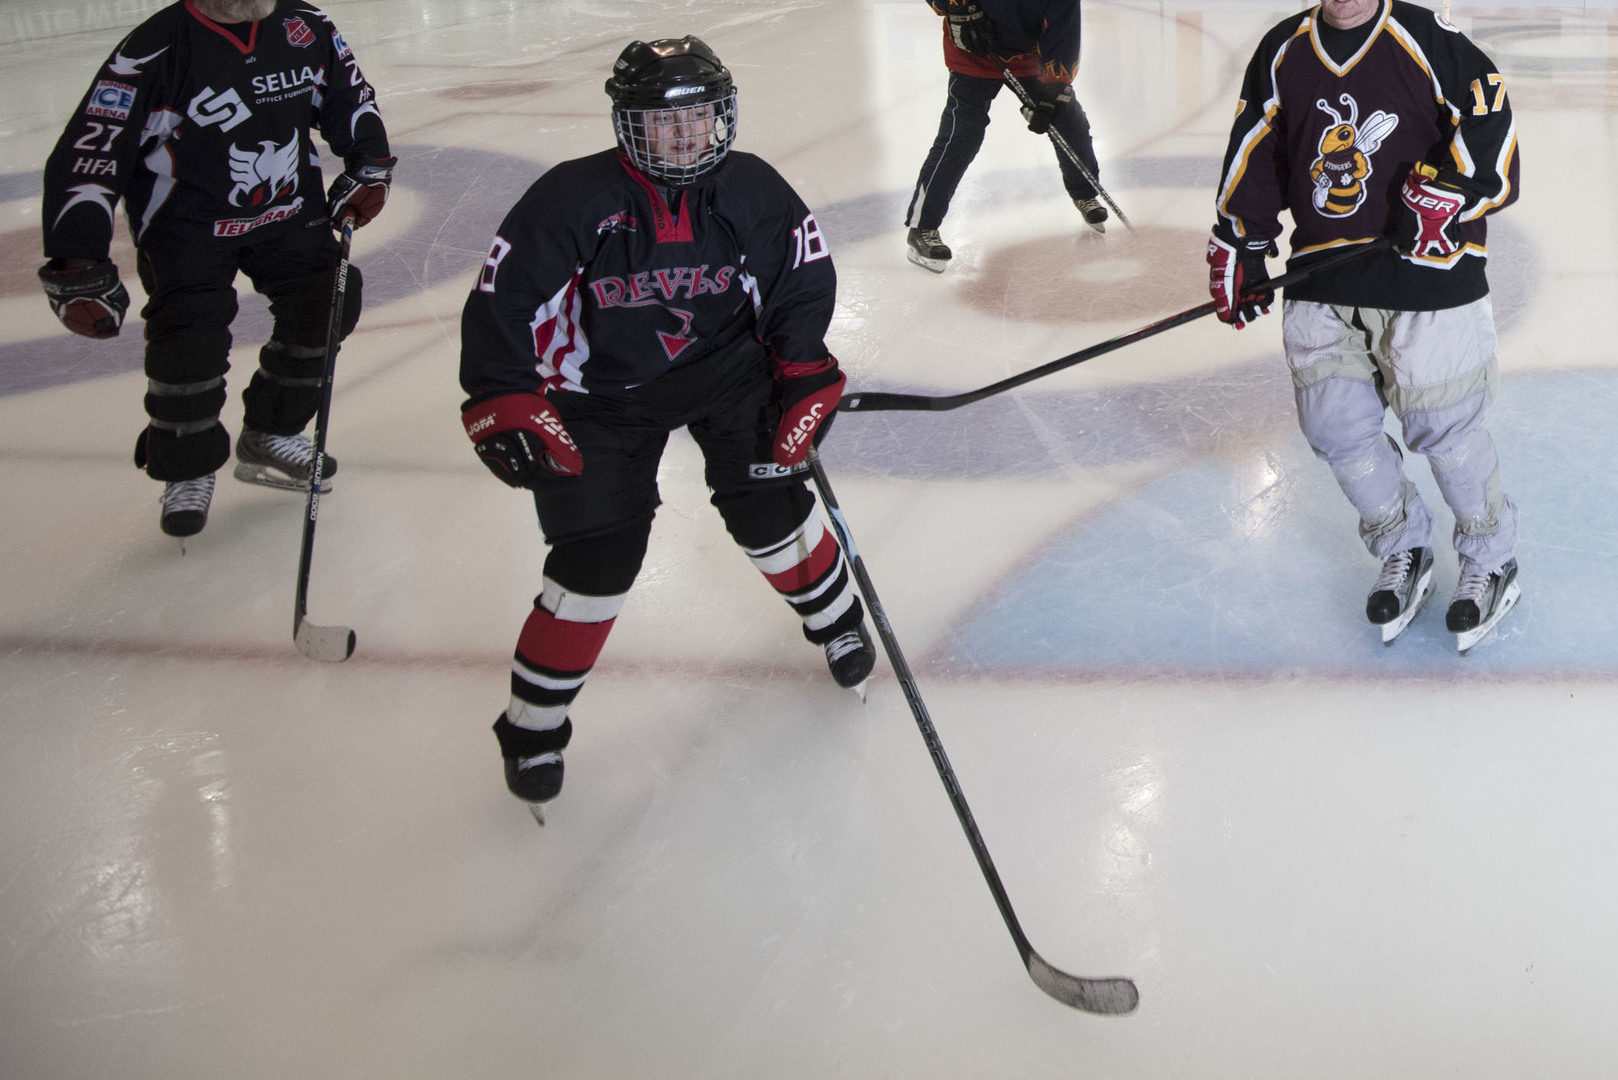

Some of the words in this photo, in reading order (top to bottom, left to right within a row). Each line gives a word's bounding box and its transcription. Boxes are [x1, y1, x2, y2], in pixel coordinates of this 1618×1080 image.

[92, 88, 132, 109] ICE
[99, 80, 135, 92] DUNDEE
[1469, 73, 1506, 117] 17
[255, 95, 282, 104] OFFICE
[87, 107, 127, 120] ARENA
[73, 122, 125, 152] 27
[72, 157, 117, 176] HFA
[1324, 160, 1352, 171] STINGERS
[791, 212, 831, 270] 18
[337, 258, 349, 293] BAUER
[467, 412, 496, 437] JOFA
[780, 402, 824, 458] JOFA
[313, 451, 324, 487] NEXUS
